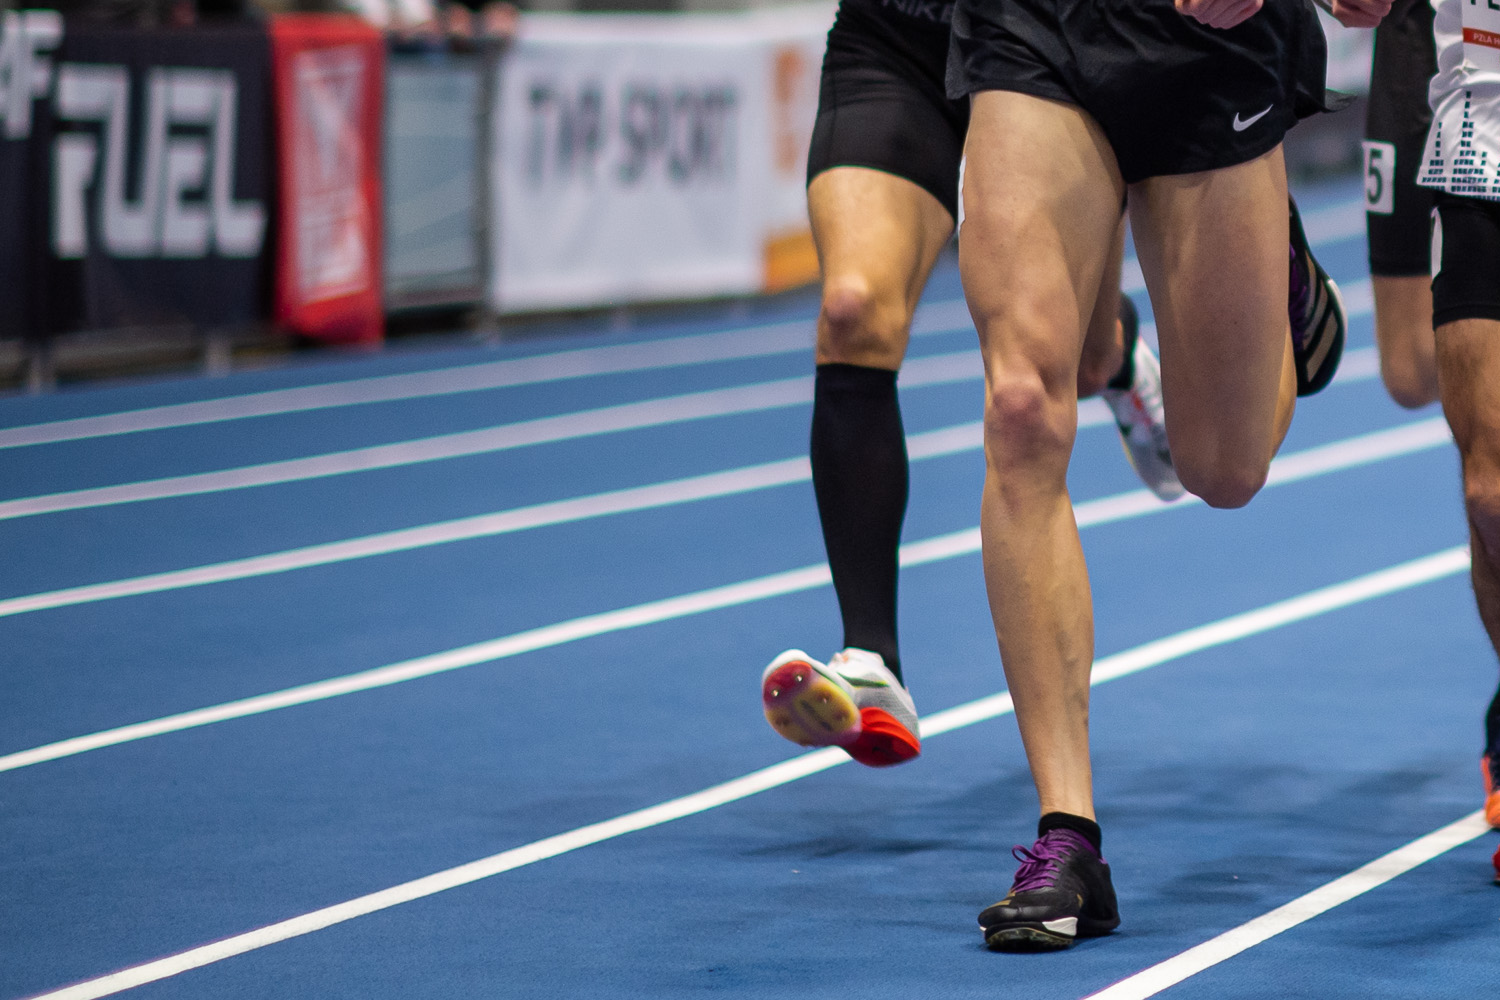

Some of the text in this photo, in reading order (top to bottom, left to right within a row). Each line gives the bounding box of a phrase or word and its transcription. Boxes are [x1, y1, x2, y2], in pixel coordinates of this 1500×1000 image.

[1473, 32, 1492, 44] PZLA
[55, 61, 267, 259] FUEL
[1367, 148, 1383, 204] 5
